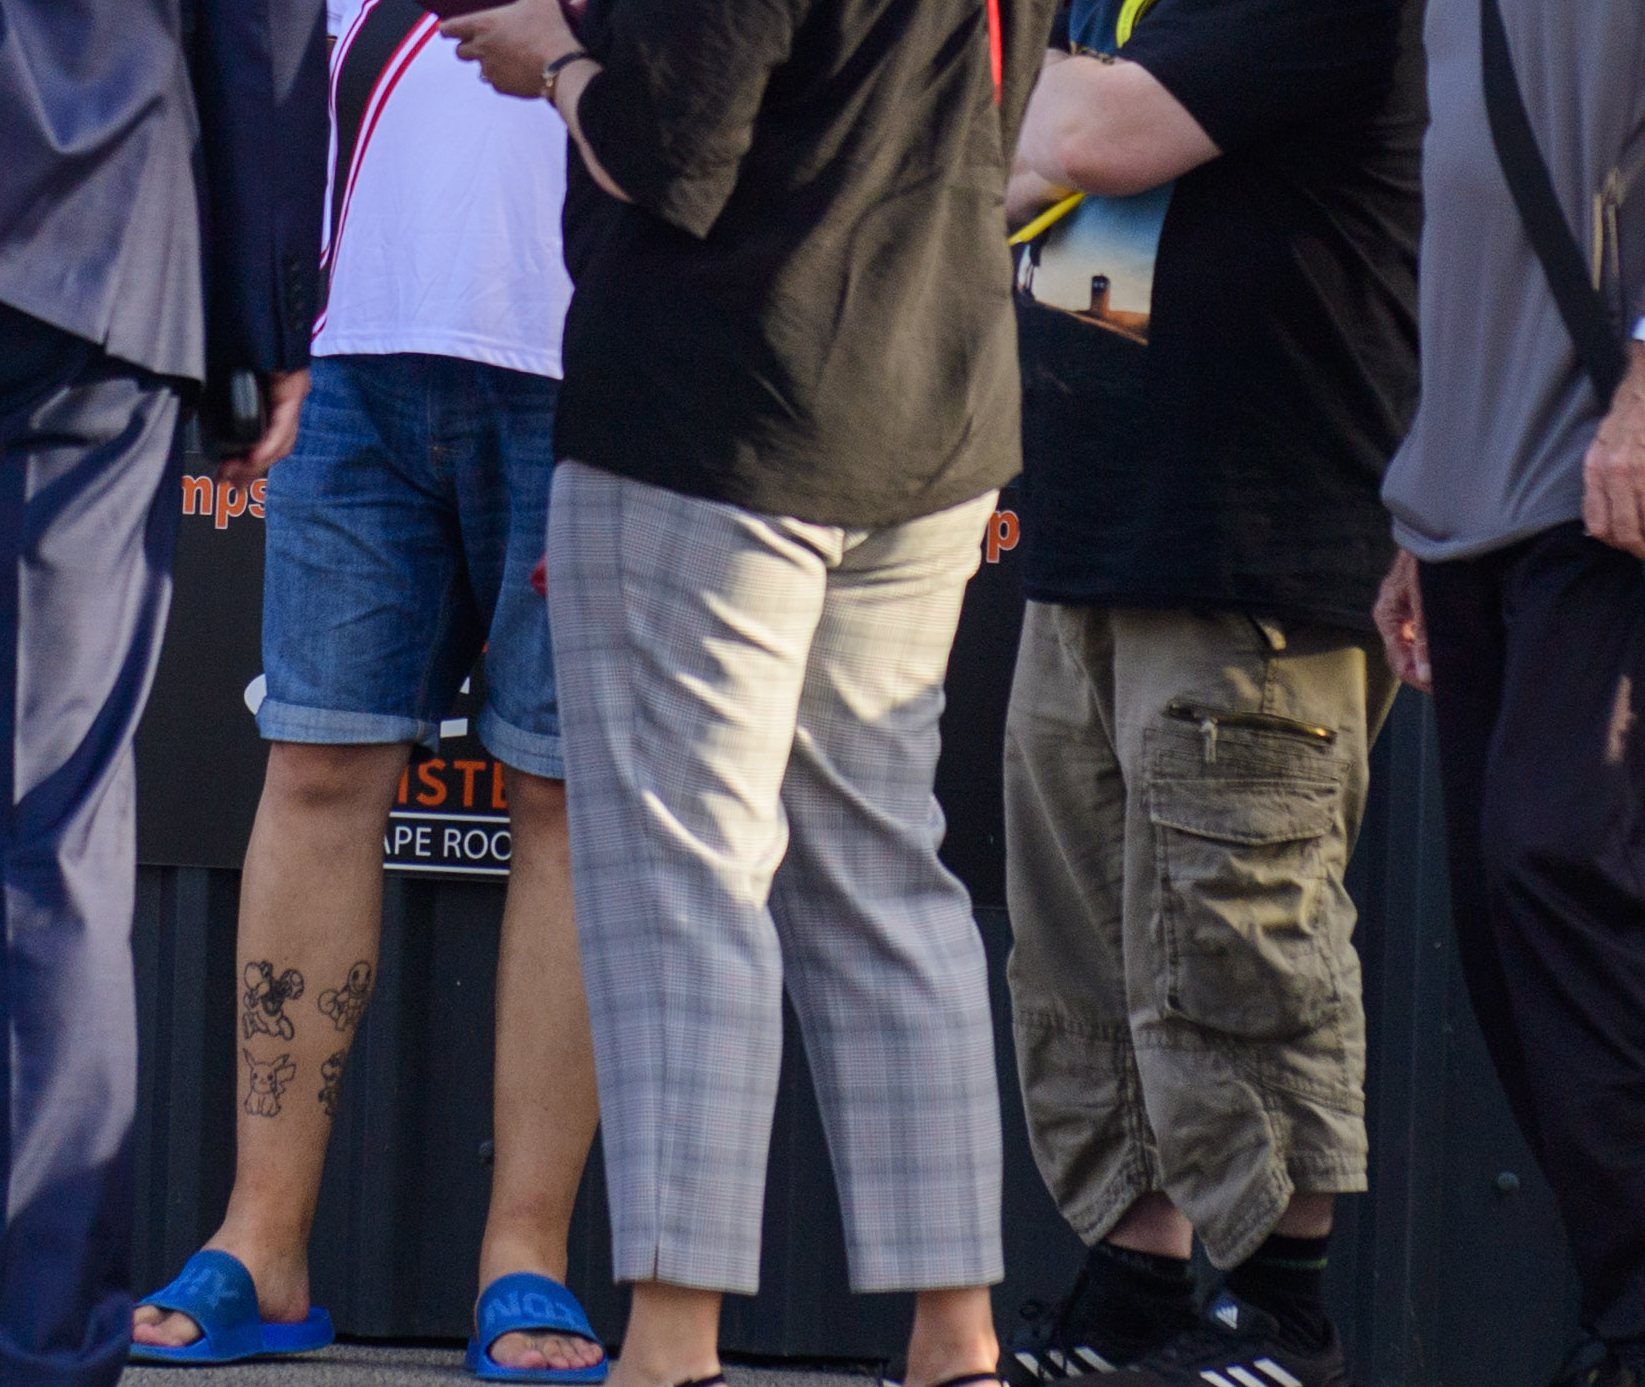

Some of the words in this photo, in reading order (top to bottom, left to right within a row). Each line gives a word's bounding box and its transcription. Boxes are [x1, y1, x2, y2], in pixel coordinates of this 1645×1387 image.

[180, 474, 269, 530] mps
[986, 509, 1021, 564] p
[398, 758, 508, 809] ISTE
[443, 827, 512, 861] ROO
